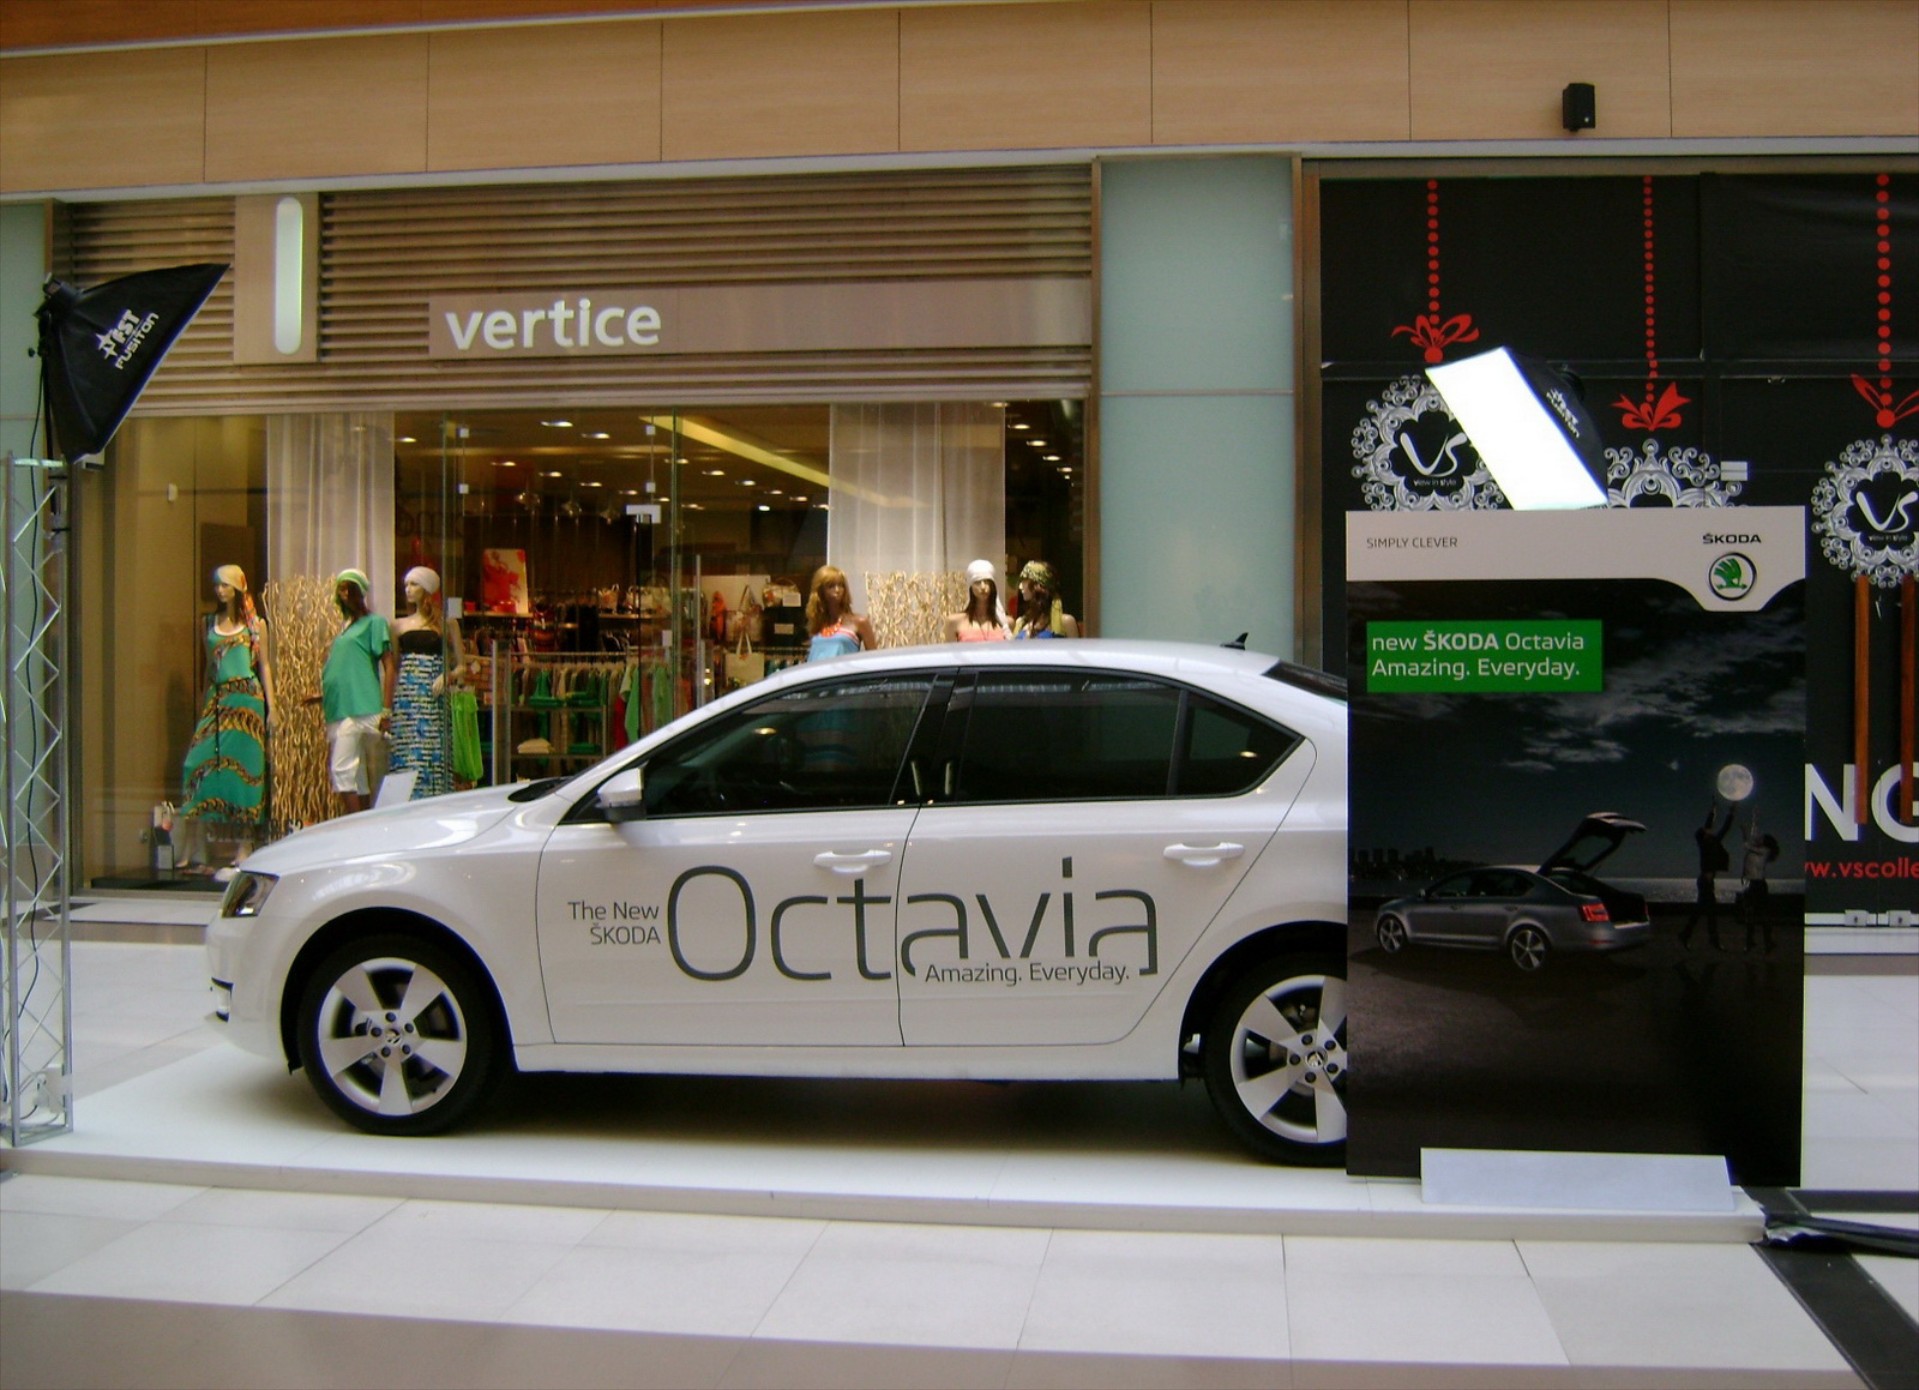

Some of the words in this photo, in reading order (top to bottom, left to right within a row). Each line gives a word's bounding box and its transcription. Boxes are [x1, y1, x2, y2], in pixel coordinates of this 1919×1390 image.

[445, 298, 661, 350] vertice
[1366, 537, 1409, 549] SIMPLY
[1412, 536, 1458, 549] CLEVER
[1702, 532, 1761, 544] ŠKODA
[1372, 637, 1417, 651] new
[1423, 630, 1499, 651] ŠKODA
[1505, 632, 1584, 650] Octavia
[1372, 658, 1470, 680] Amazing.
[1478, 657, 1580, 680] Everyday.
[567, 902, 606, 921] The
[613, 902, 660, 921] New
[668, 857, 1158, 981] Octavia
[590, 923, 661, 945] ŠKODA
[925, 962, 1022, 987] Amazing.
[1029, 960, 1130, 986] Everyday.
